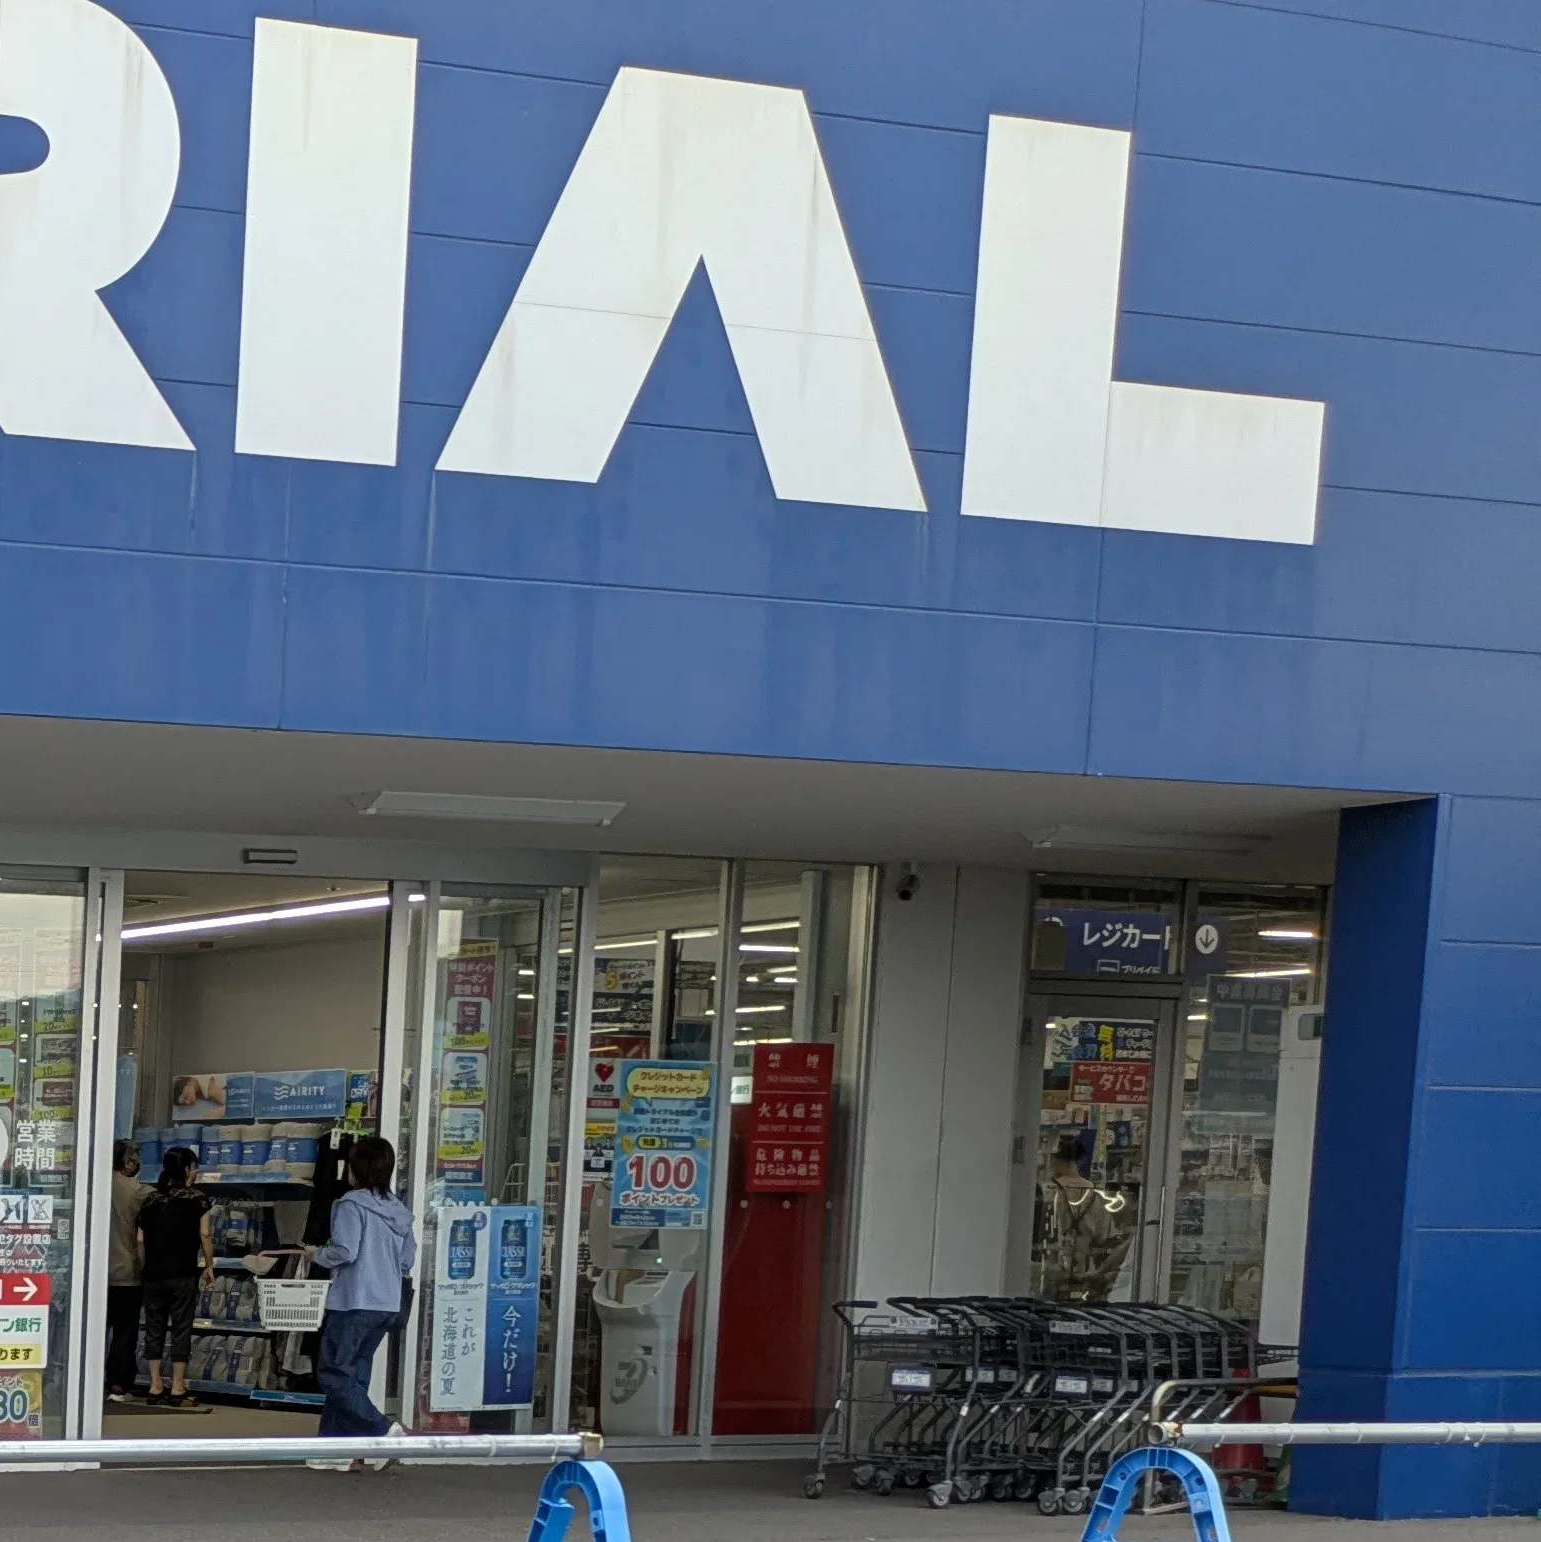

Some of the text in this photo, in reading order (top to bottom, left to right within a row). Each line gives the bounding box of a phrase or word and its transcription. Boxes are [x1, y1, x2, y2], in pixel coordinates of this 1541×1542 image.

[289, 1085, 326, 1098] AIRITY
[593, 1084, 614, 1092] AED
[1098, 1073, 1147, 1092] タバコ
[16, 1118, 57, 1144] 営業
[14, 1147, 57, 1171] 時間
[628, 1154, 696, 1190] 100
[461, 1307, 477, 1357] これが
[440, 1306, 458, 1396] 北海道の夏
[28, 1412, 40, 1428] 倍
